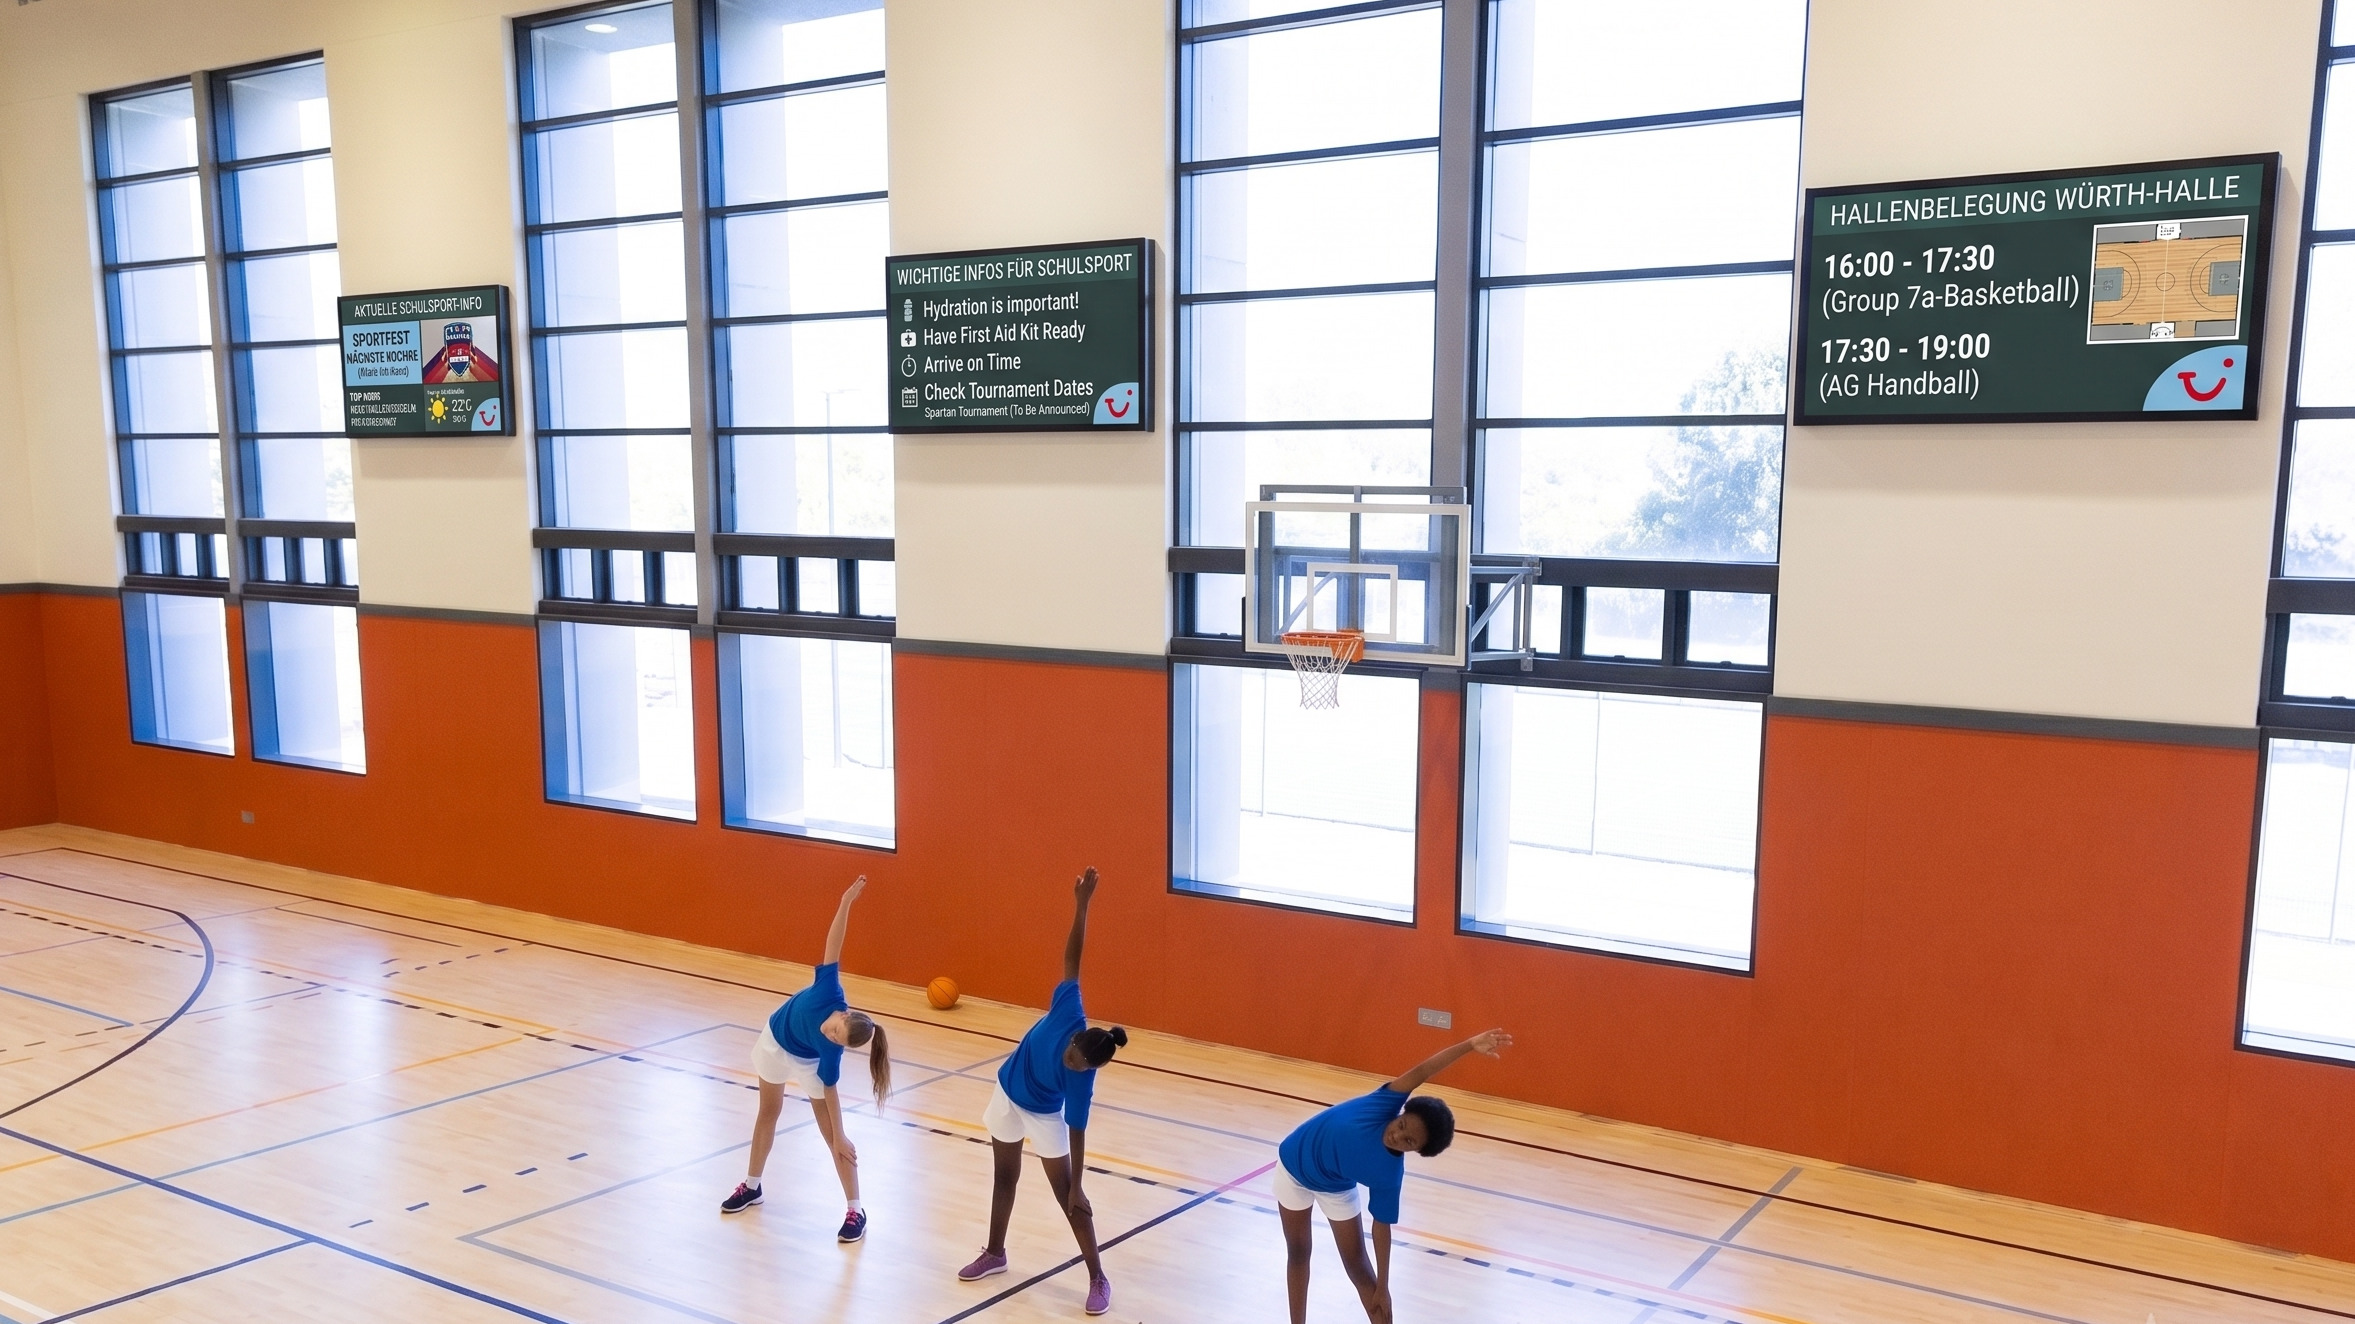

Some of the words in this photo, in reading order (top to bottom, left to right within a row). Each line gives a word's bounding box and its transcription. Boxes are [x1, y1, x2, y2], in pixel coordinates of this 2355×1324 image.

[1830, 189, 2047, 226] HALLENBELEGUNG
[2055, 175, 2240, 210] WÜRTH-HALLE
[897, 265, 961, 285] WICHTIGE
[964, 263, 1004, 281] INFOS
[1007, 258, 1033, 278] FÜR
[1038, 253, 1132, 277] SCHULSPORT
[1825, 251, 1894, 279] 16:00
[1922, 244, 1995, 273] 17:30
[354, 302, 397, 317] AKTUELLE
[399, 296, 482, 314] SCHULSPORT-INFO
[923, 298, 987, 321] Hydration
[992, 297, 1003, 313] is
[1007, 292, 1080, 316] important!
[1822, 287, 1900, 319] (Group
[1907, 277, 2080, 309] 7a-Basketball)
[353, 330, 410, 347] SPORTFEST
[924, 328, 957, 345] Have
[961, 326, 990, 343] First
[994, 324, 1017, 342] Aid
[1020, 323, 1039, 340] Kit
[1044, 320, 1086, 344] Ready
[924, 356, 964, 373] Arrive
[968, 356, 983, 371] on
[987, 353, 1021, 370] Time
[1821, 337, 1891, 364] 17:30
[1918, 333, 1991, 360] 19:00
[925, 383, 965, 400] Check
[969, 381, 1049, 399] Tournament
[1054, 379, 1093, 396] Dates
[1819, 372, 1860, 403] (AG
[1868, 369, 1980, 400] Handball)
[925, 406, 956, 420] Spartan
[959, 405, 1008, 417] Tournament
[1010, 404, 1024, 418] (To
[1026, 404, 1037, 415] Be
[1039, 402, 1090, 416] Announced)
